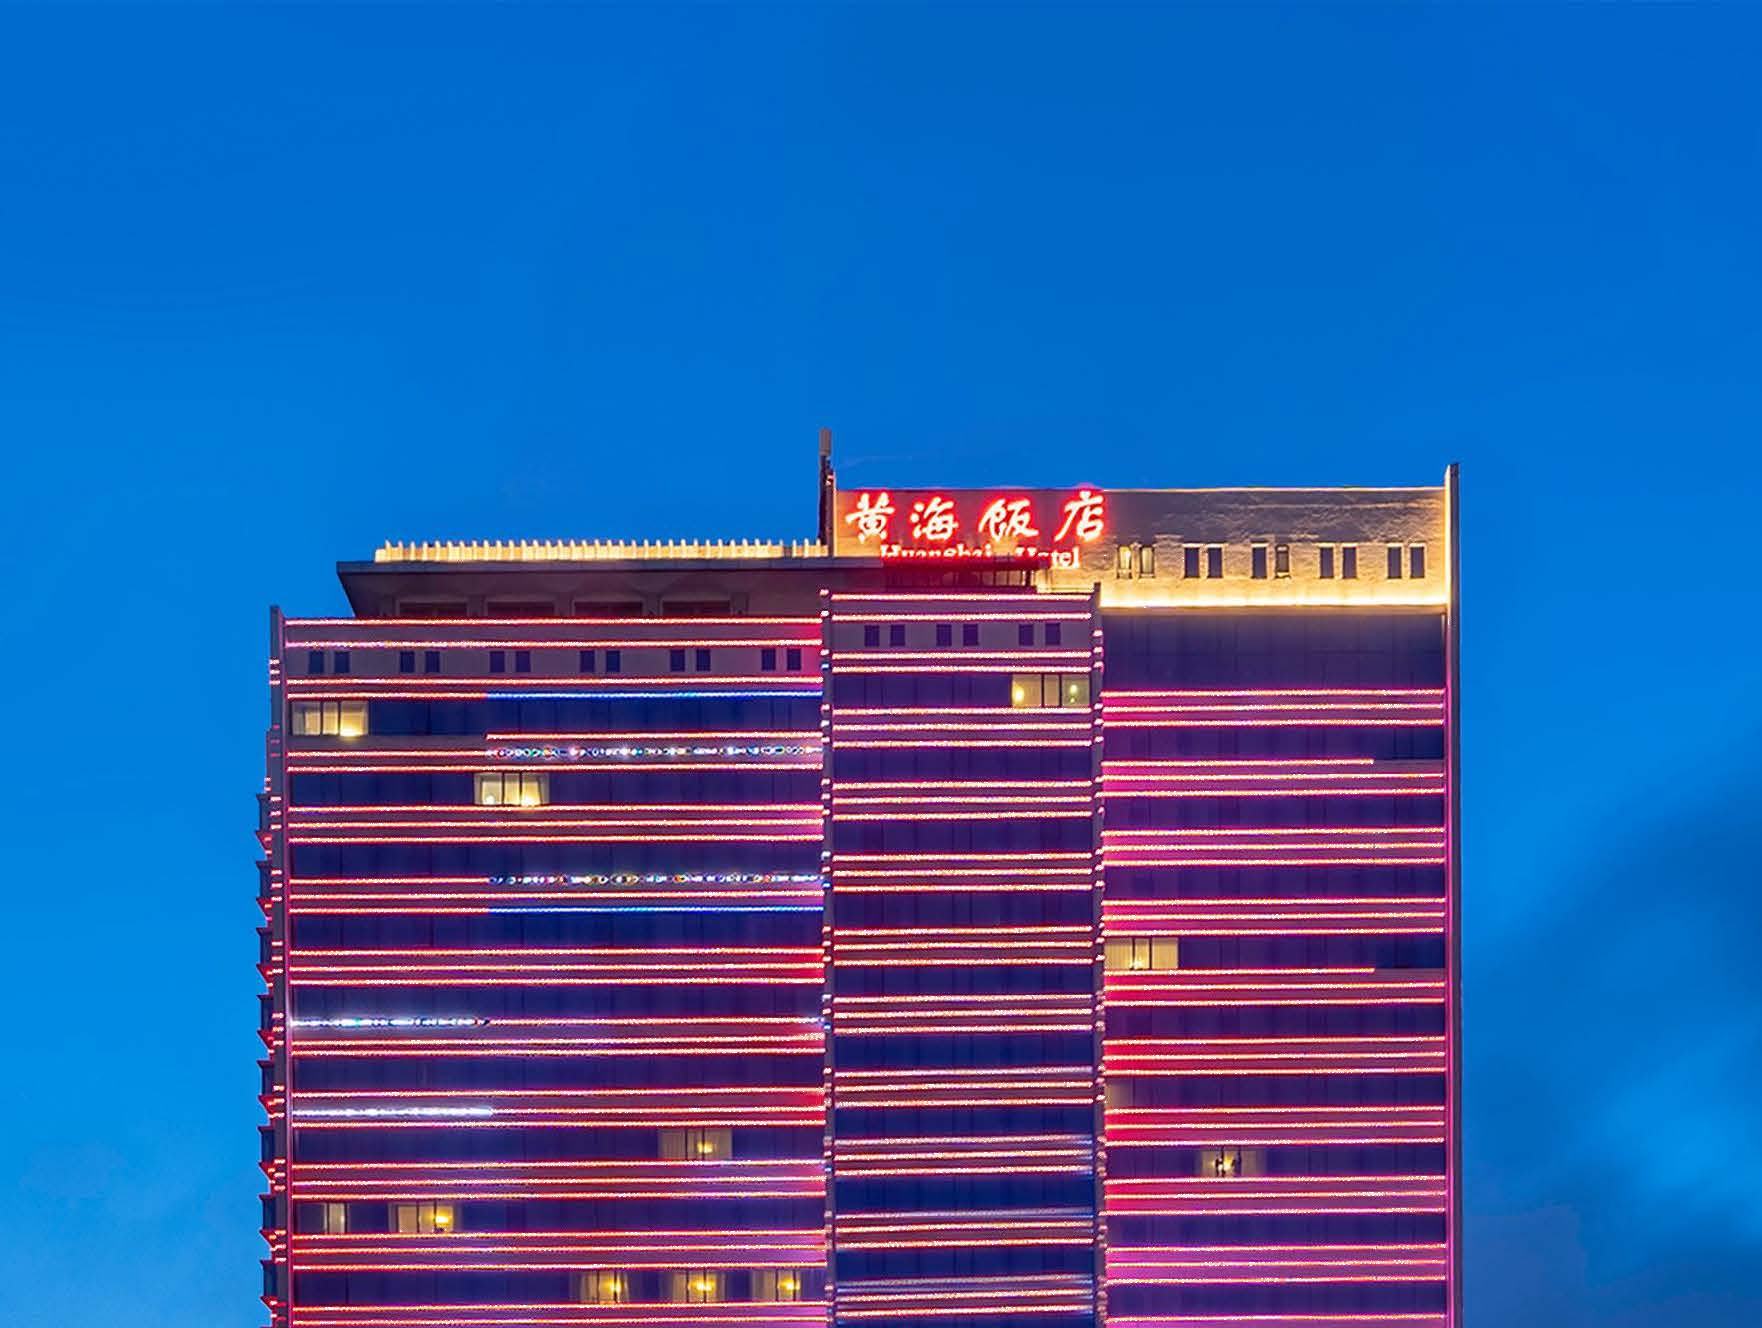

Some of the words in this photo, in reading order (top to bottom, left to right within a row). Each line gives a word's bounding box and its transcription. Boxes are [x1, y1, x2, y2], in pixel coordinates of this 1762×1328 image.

[845, 490, 1105, 543] 黄海饭店
[1015, 546, 1080, 569] tel
